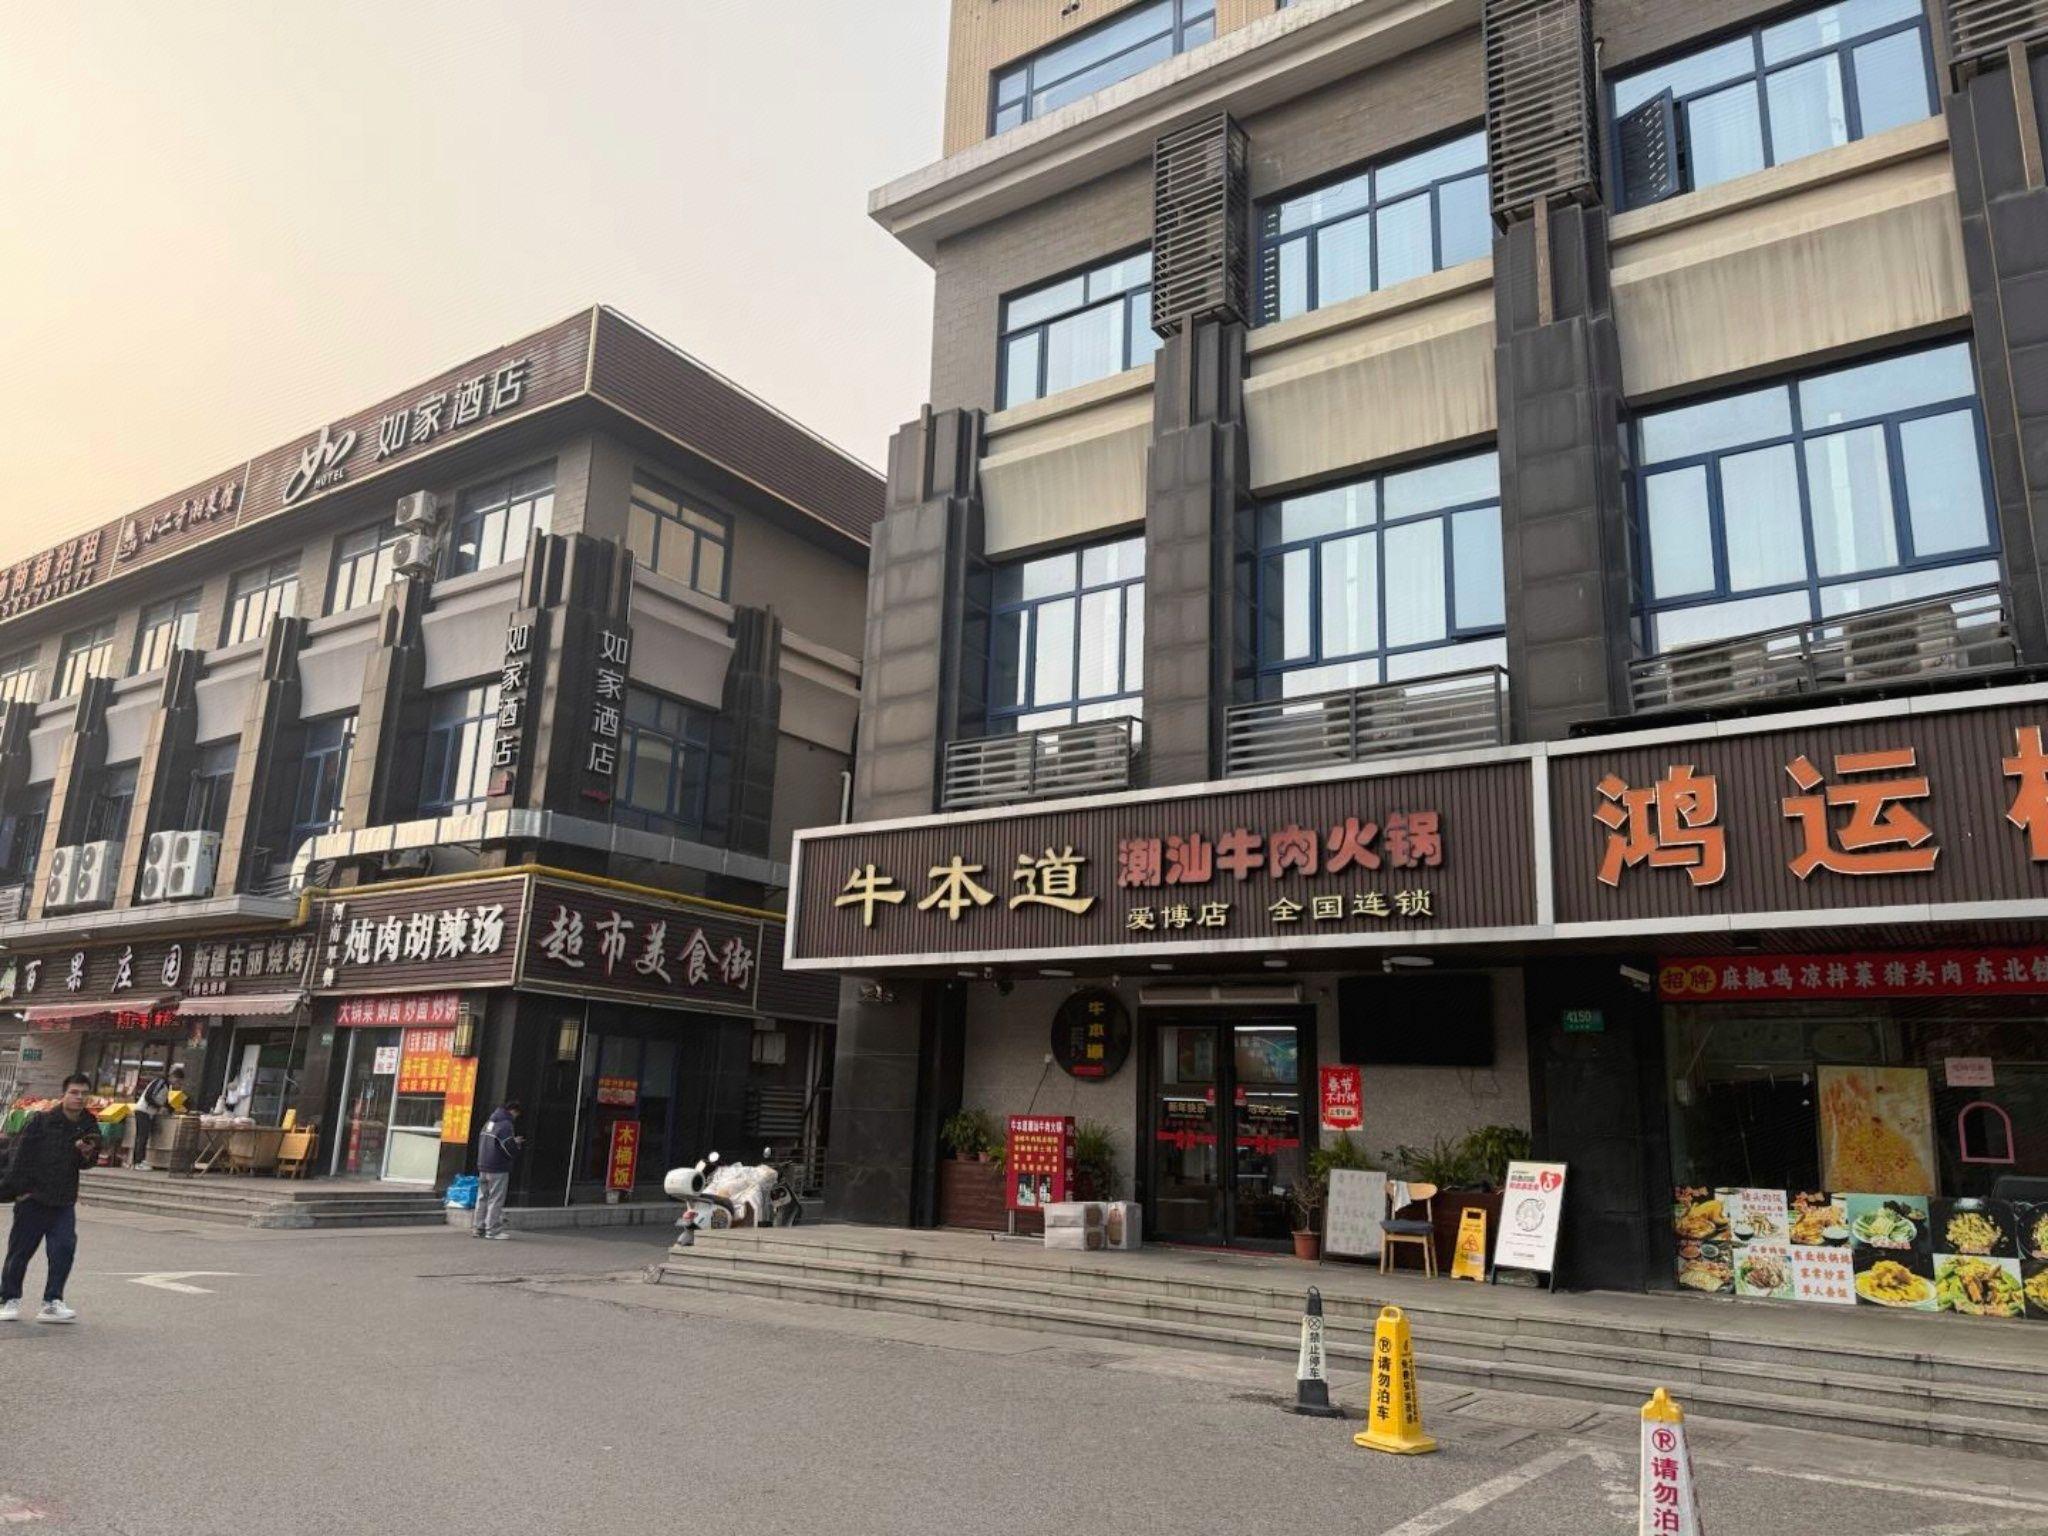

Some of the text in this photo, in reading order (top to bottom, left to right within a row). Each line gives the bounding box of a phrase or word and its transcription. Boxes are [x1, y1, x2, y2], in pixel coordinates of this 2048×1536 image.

[376, 359, 527, 461] 如家酒店
[495, 625, 530, 766] 如家酒店
[588, 630, 628, 775] 如家酒店
[1118, 811, 1442, 887] 潮汕牛肉火锅
[834, 845, 1095, 927] 牛本道
[1126, 889, 1434, 930] 爱博店 全国连锁
[25, 944, 181, 993] 百果庄园
[342, 903, 504, 965] 炖肉胡辣汤
[540, 904, 754, 990] 超市美食街
[1663, 969, 1713, 991] 招牌
[1721, 963, 1793, 991] 麻椒鸡
[1800, 961, 1873, 988] 凉拌菜
[1884, 959, 1963, 986] 猪头肉
[613, 1124, 635, 1186] 木桶饭
[1309, 1332, 1320, 1379] 禁止停车
[1377, 1356, 1391, 1420] 请勿泊车
[1651, 1457, 1679, 1536] 请勿泊
